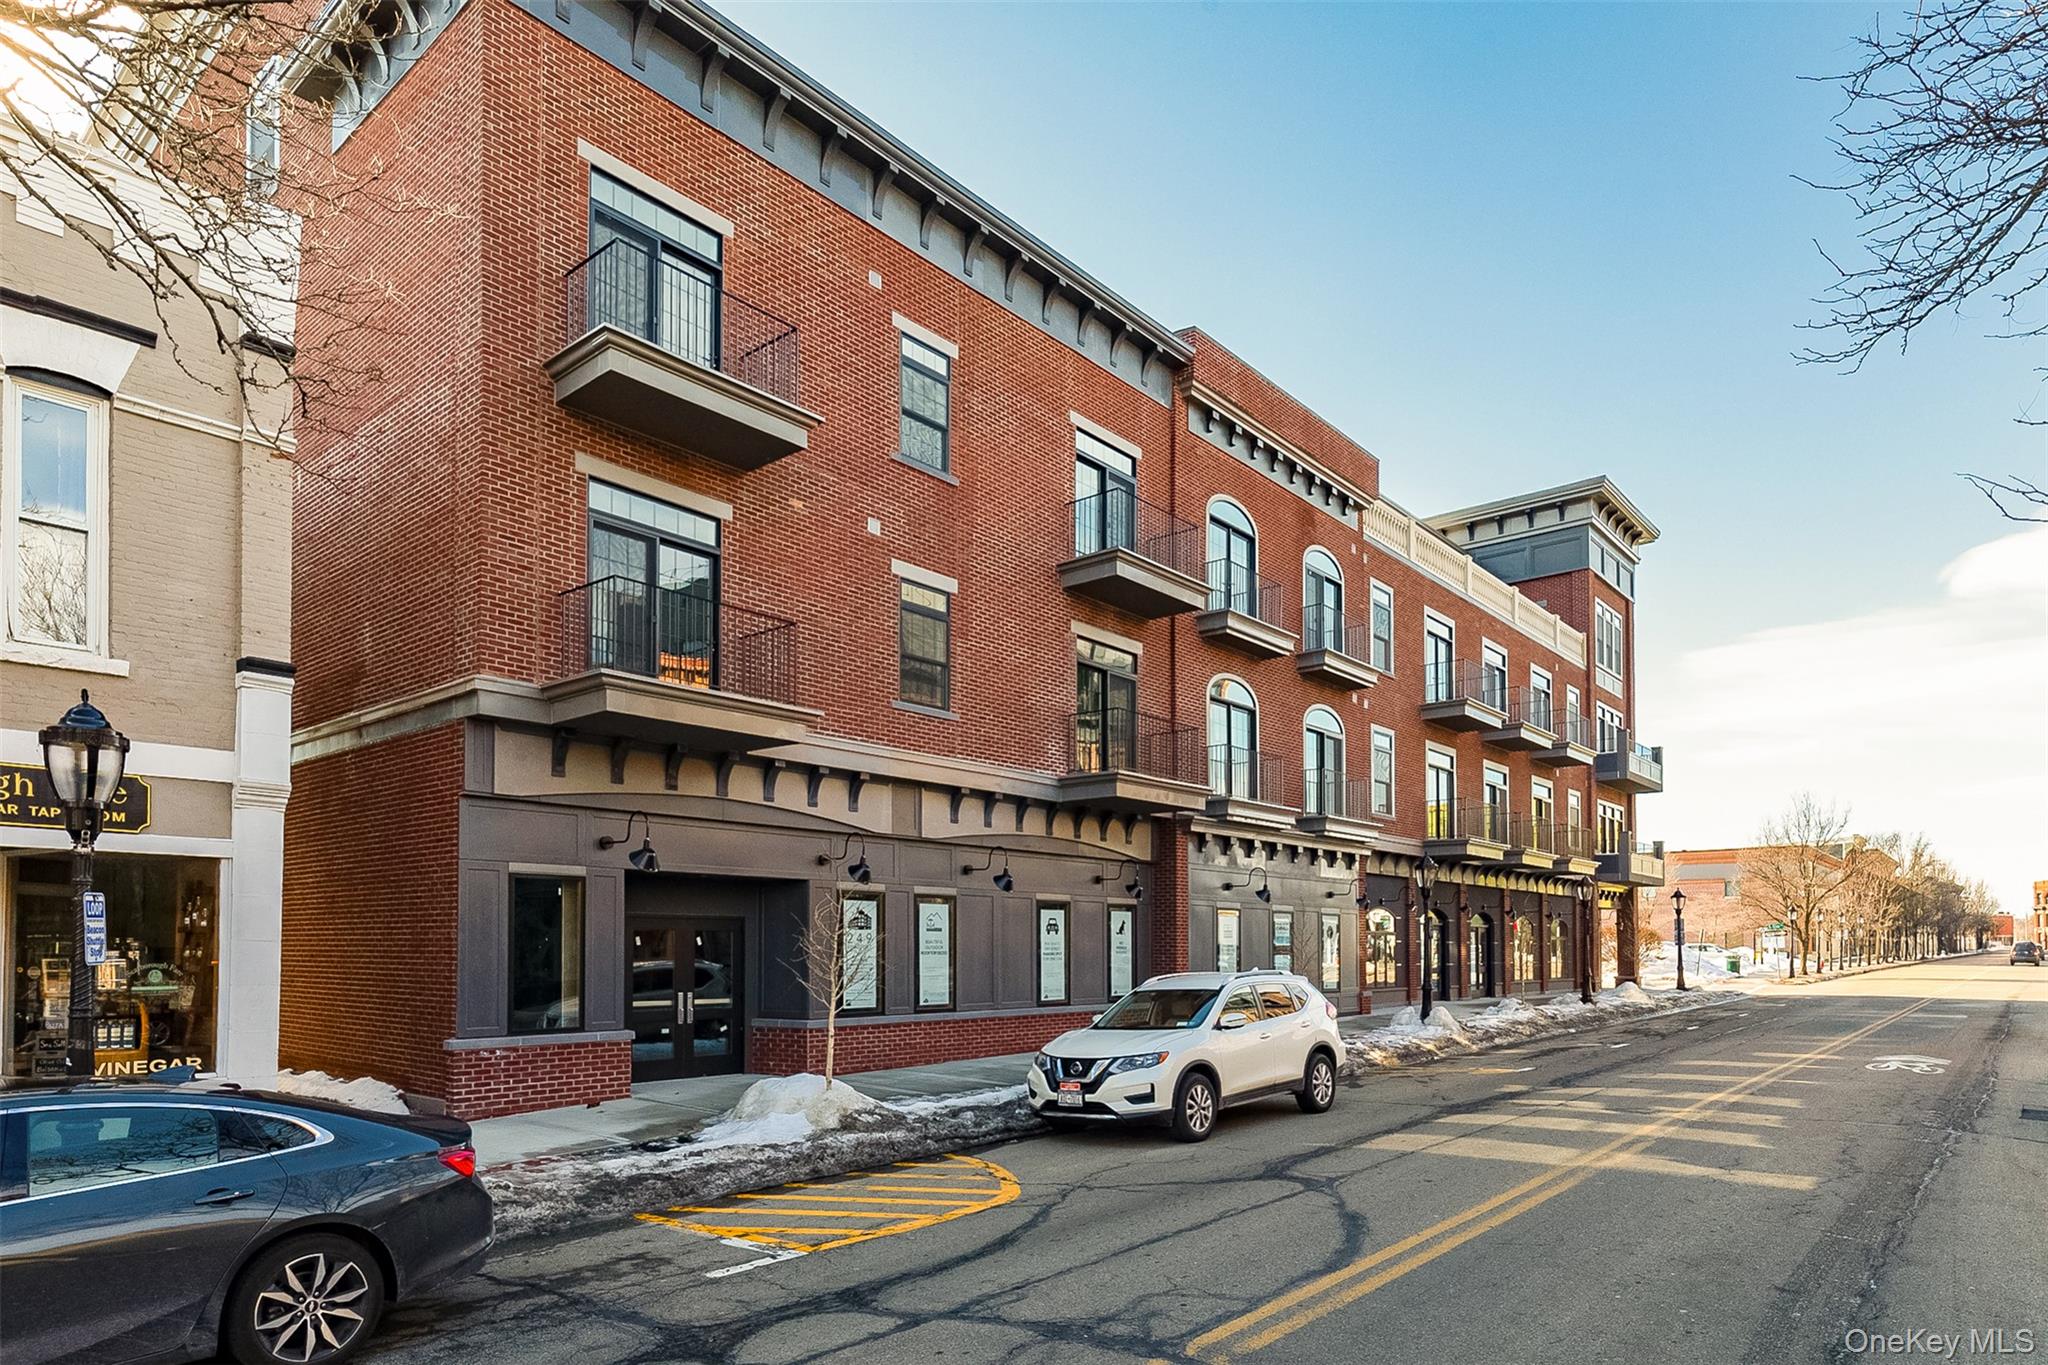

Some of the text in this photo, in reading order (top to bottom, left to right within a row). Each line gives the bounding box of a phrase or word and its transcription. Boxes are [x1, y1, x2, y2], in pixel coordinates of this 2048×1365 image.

[28, 805, 61, 818] TAP
[87, 902, 103, 916] LOOP
[86, 925, 105, 934] Beacon
[86, 936, 105, 945] Shuttle
[94, 1056, 203, 1077] VINEGAR
